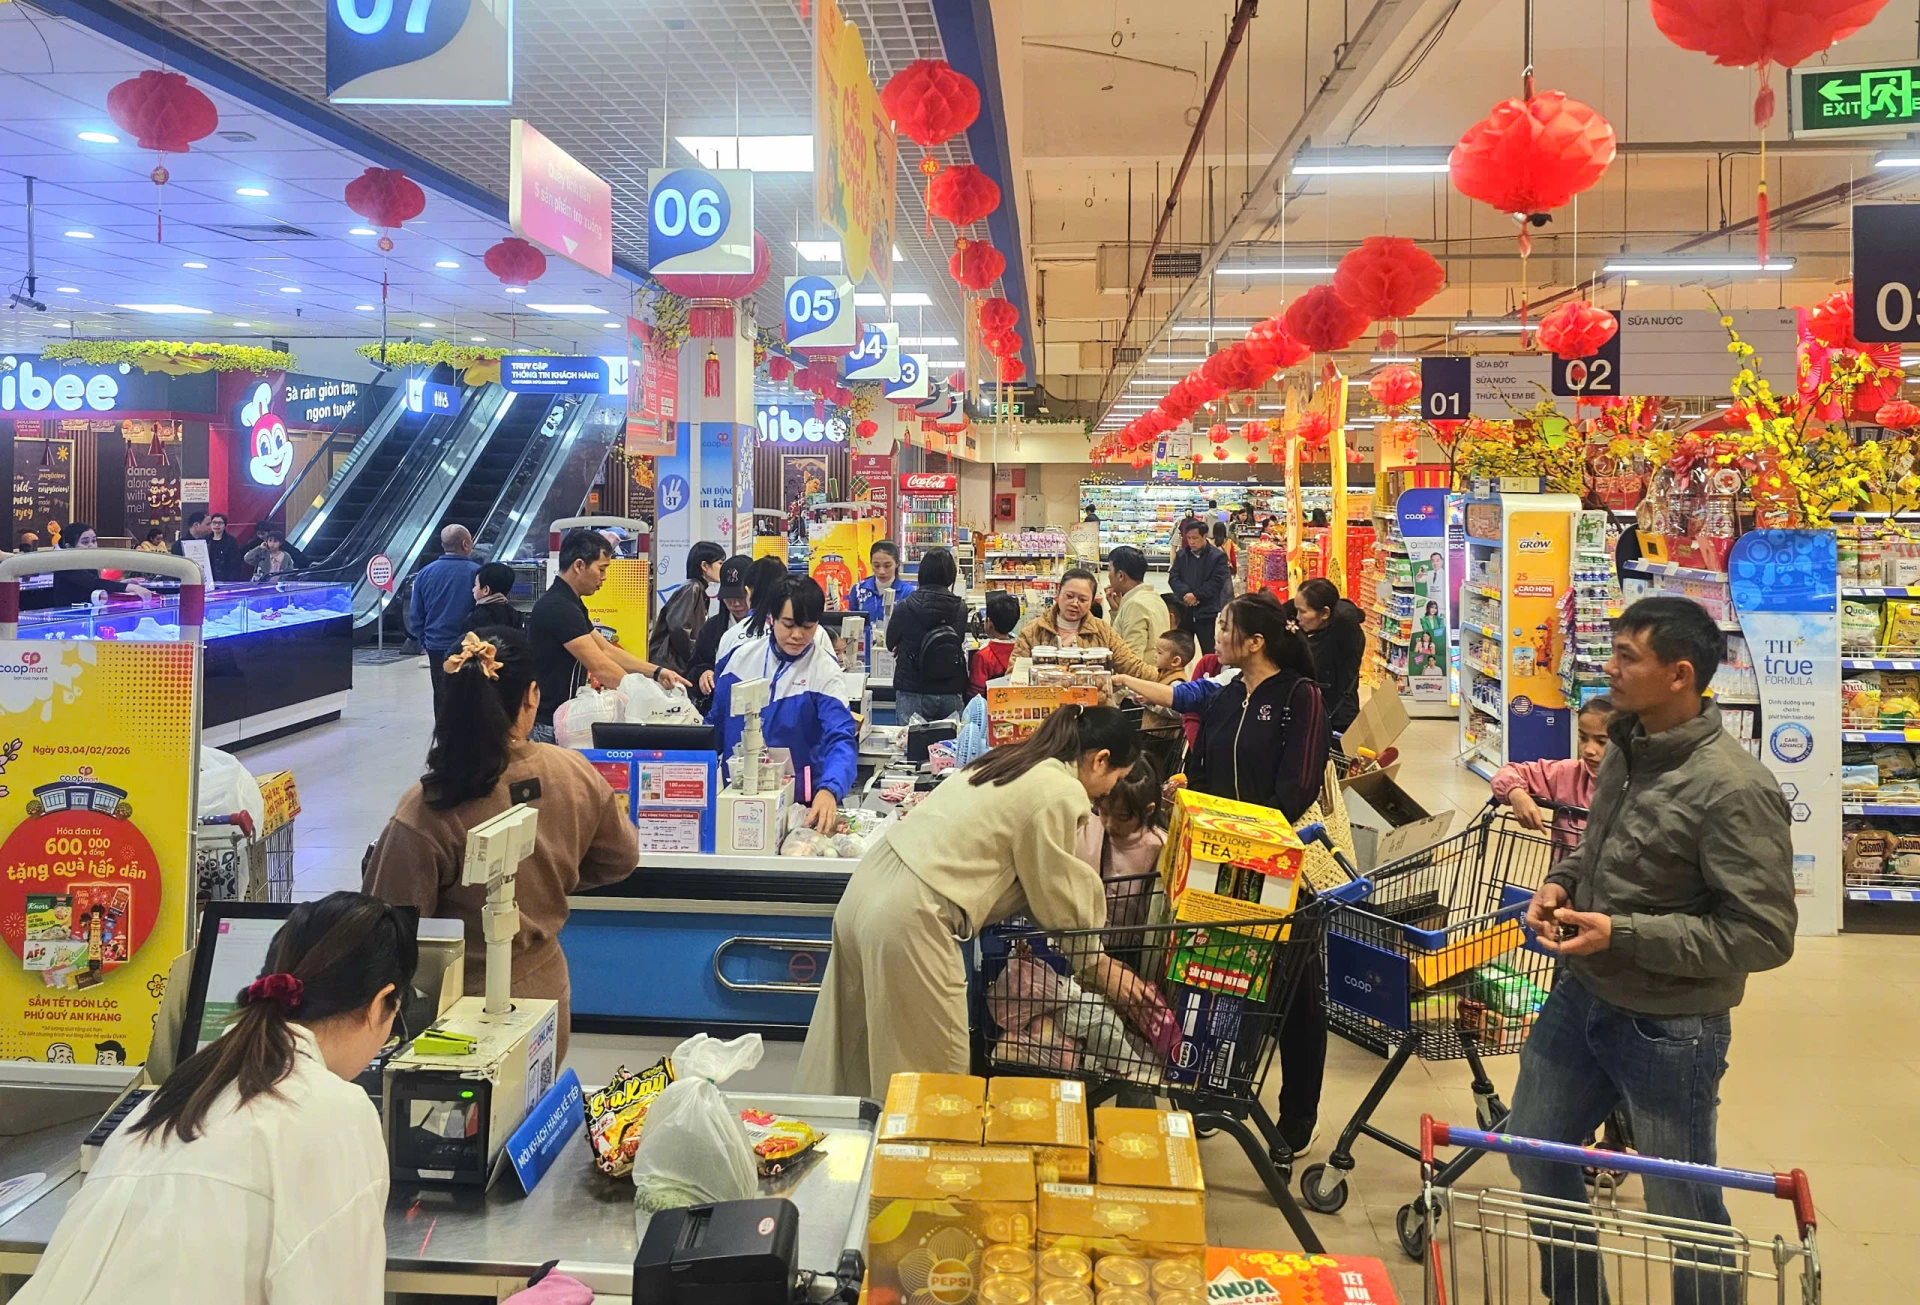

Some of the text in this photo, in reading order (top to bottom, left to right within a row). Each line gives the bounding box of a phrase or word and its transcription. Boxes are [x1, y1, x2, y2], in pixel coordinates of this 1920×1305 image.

[1823, 101, 1861, 116] EXIT
[534, 182, 540, 197] 5
[654, 188, 722, 237] 06
[789, 290, 834, 322] 05
[1876, 282, 1920, 332] 0
[1628, 316, 1649, 326] SỮA
[1651, 316, 1683, 326] NƯỚC
[512, 362, 548, 372] TRUY CẬP
[1494, 361, 1509, 369] BỘT
[512, 370, 538, 379] THÔNG
[552, 370, 578, 380] KHÁCH
[578, 370, 600, 380] HÀNG
[1476, 376, 1516, 384] SỮA NƯỚC
[1566, 359, 1612, 391] 02
[300, 384, 316, 400] rán
[319, 382, 340, 402] giòn
[341, 382, 358, 396] tan,
[1476, 392, 1498, 400] THỨC
[1526, 392, 1536, 400] BÉ
[1430, 392, 1460, 416] 01
[306, 405, 330, 422] ngon
[128, 466, 157, 476] dance
[906, 475, 946, 489] Coca-Cola
[126, 489, 146, 501] with
[666, 496, 678, 506] 3T
[126, 502, 145, 513] me!
[1516, 572, 1528, 580] 25
[1765, 640, 1793, 654] TH
[1764, 655, 1813, 675] true
[1764, 676, 1812, 686] FORMULA
[32, 745, 56, 755] Ngày
[56, 827, 102, 836] Hóa đơn từ
[1202, 832, 1219, 842] TRÀ
[1228, 837, 1252, 849] LONG
[89, 848, 106, 857] đồng
[1200, 840, 1232, 859] TEA
[7, 858, 147, 884] tặng Quà hấp dẫn
[28, 902, 49, 910] Knorr
[26, 946, 46, 960] AFC
[28, 994, 118, 1010] SẮM TẾT ĐÓN LỘC
[24, 1008, 122, 1022] PHÚ QUÝ AN KHANG
[1180, 1043, 1190, 1067] PEPSI
[518, 1085, 580, 1169] MỜI KHÁCH HÀNG KẾ TIẾP
[930, 1276, 970, 1287] PEPSI
[1339, 1270, 1362, 1286] TẾT
[1244, 1296, 1279, 1304] CAM
[1344, 1286, 1370, 1300] VUI
